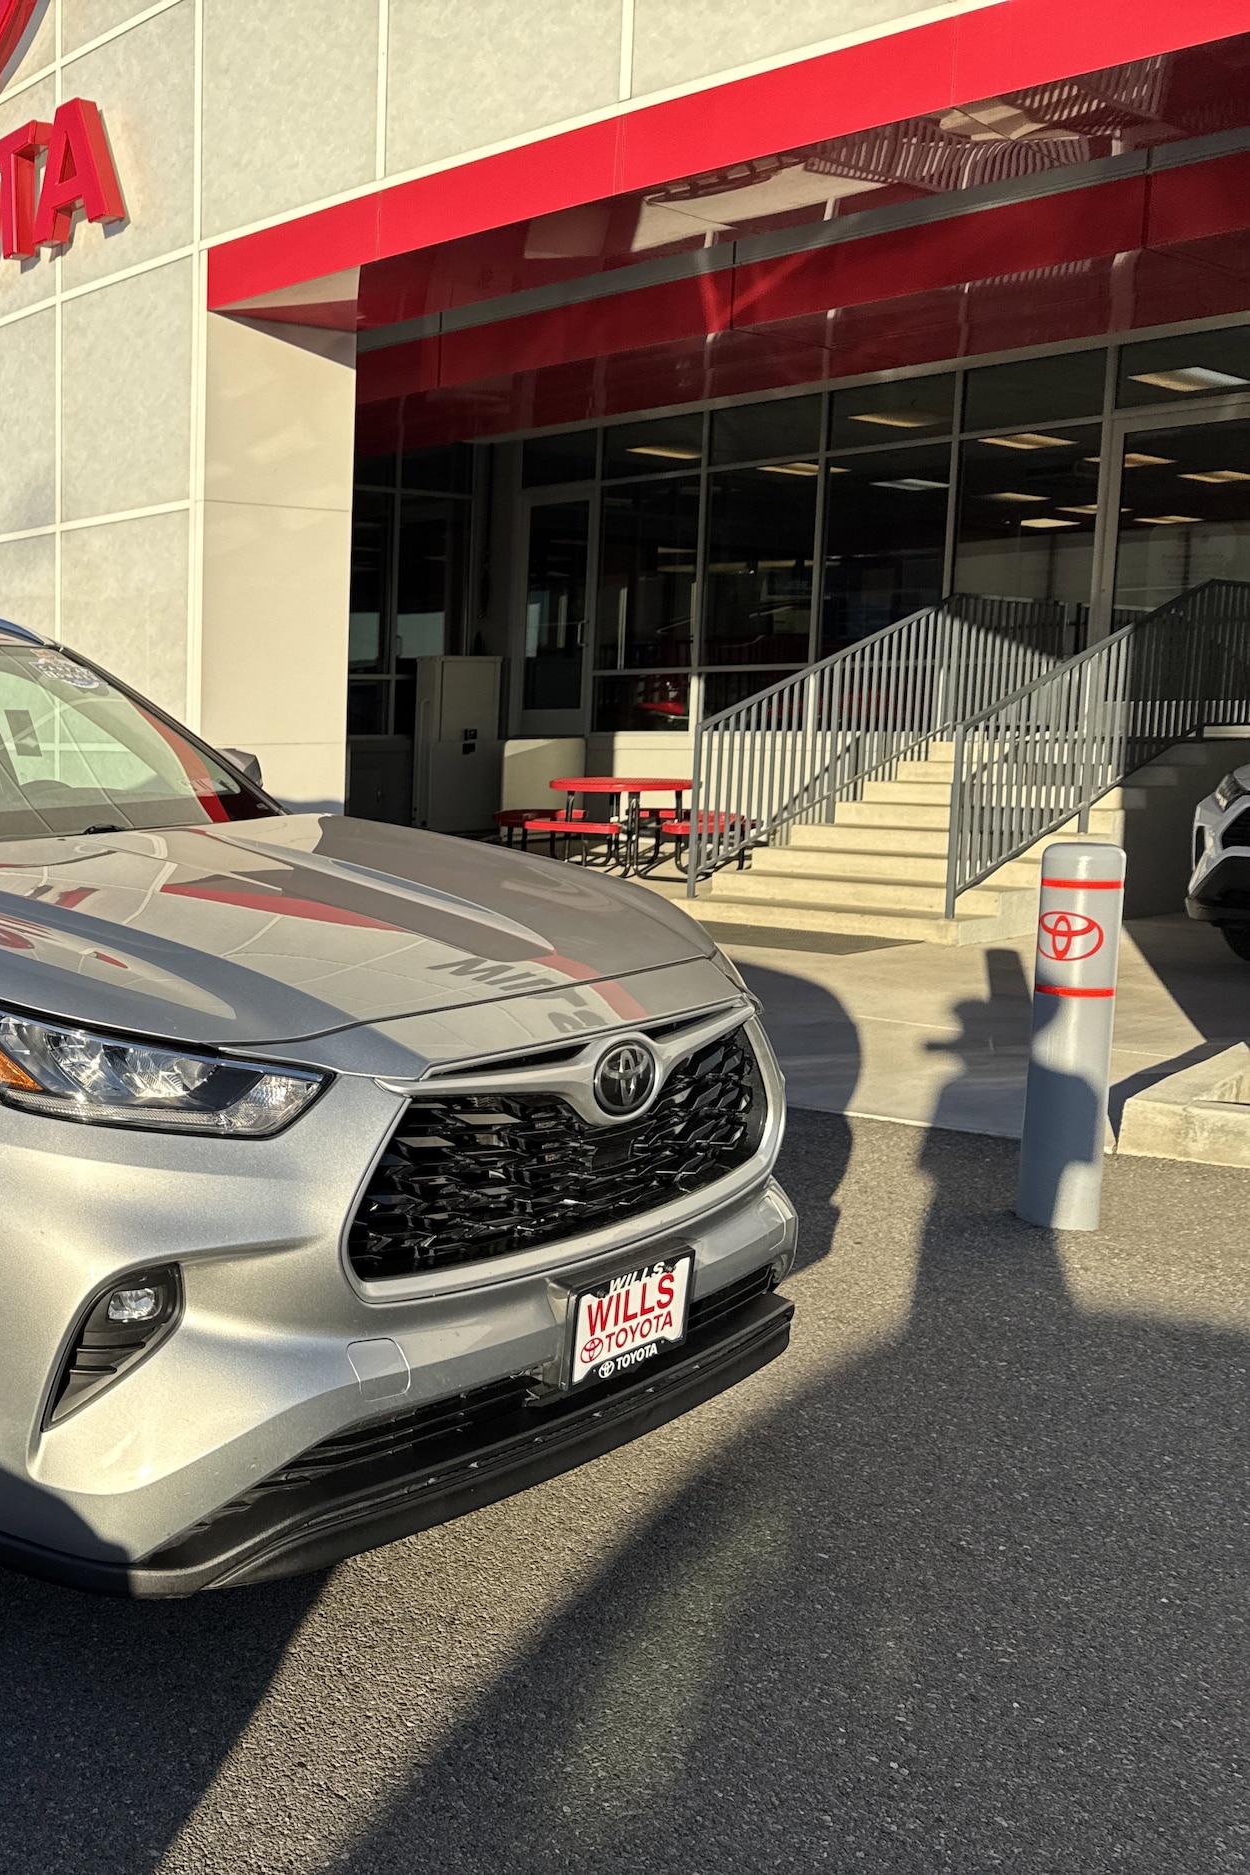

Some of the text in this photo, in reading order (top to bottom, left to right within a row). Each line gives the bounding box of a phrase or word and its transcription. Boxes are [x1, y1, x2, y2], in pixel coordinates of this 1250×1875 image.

[610, 1261, 666, 1293] WILLS
[587, 1273, 675, 1337] WILLS
[605, 1310, 673, 1353] TOYOTA
[616, 1342, 659, 1371] TOYOTA
